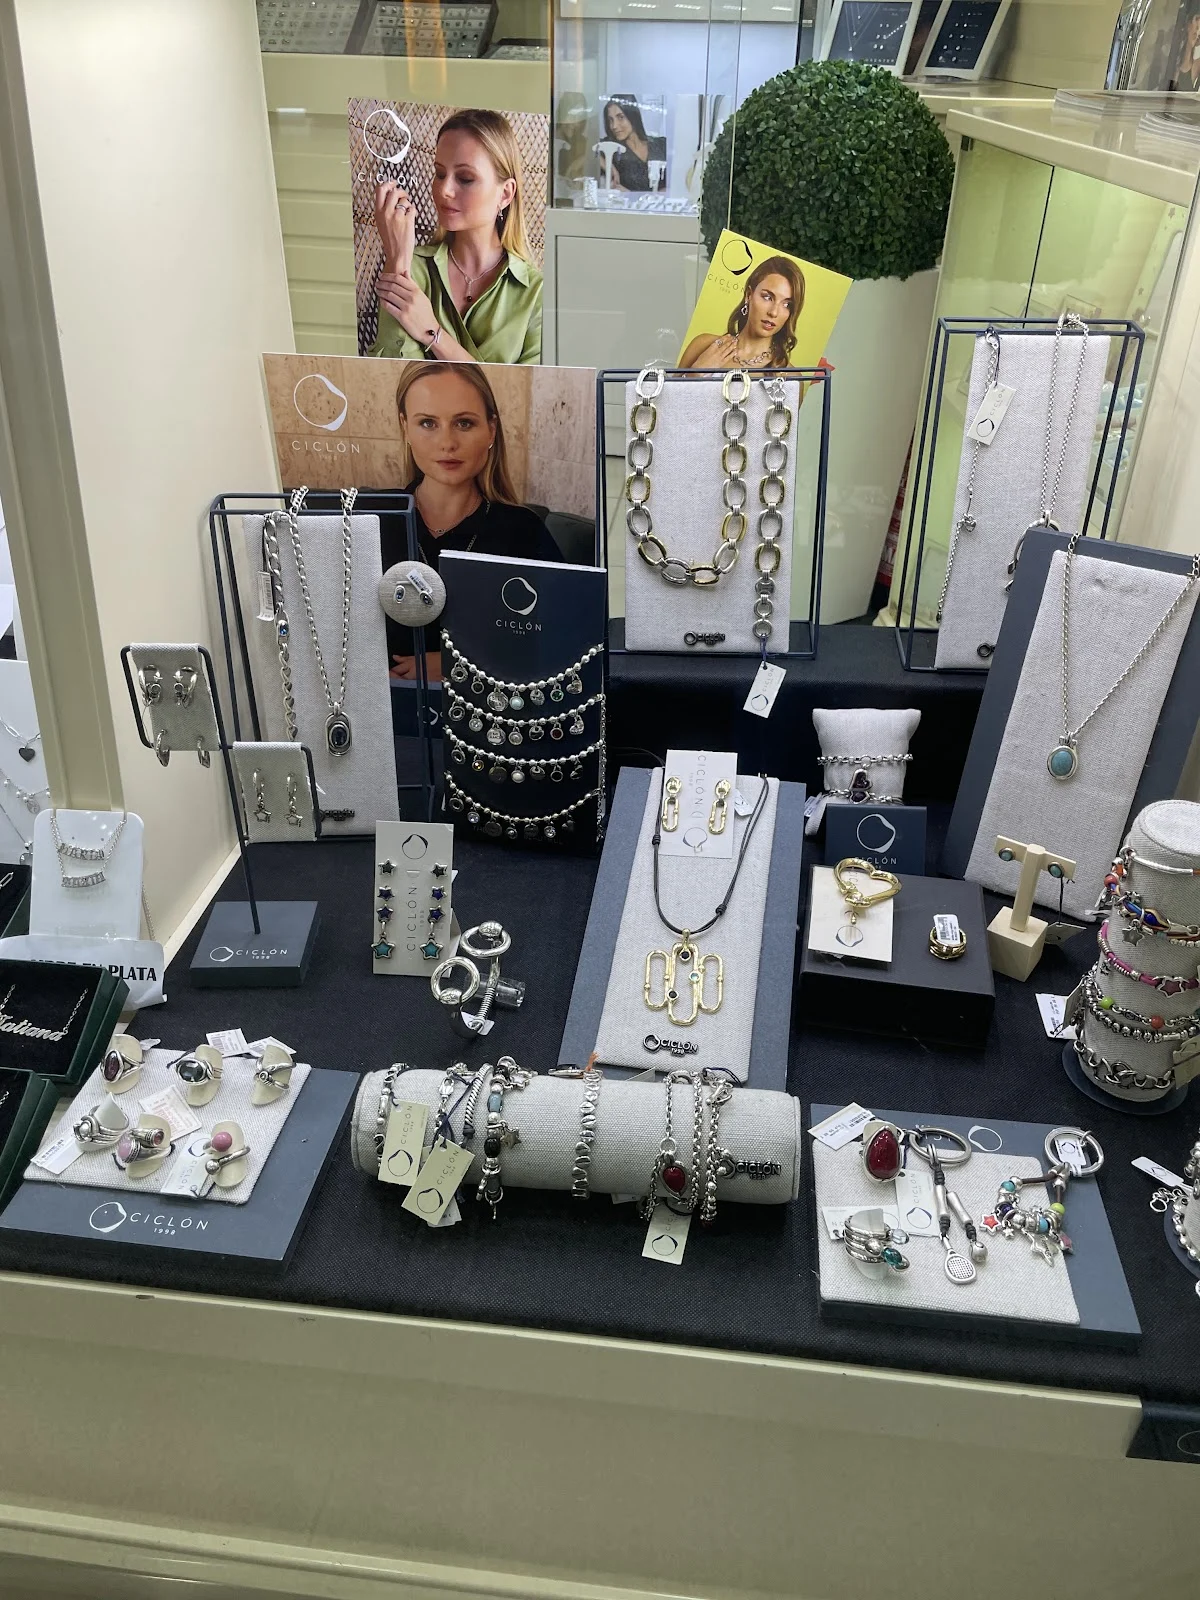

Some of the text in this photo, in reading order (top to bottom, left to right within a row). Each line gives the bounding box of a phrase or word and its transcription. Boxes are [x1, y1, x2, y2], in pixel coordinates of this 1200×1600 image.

[291, 440, 361, 454] CICLÓN
[495, 619, 542, 632] CICLÓN
[695, 755, 707, 805] CICLÓN
[855, 857, 897, 865] CLÓN
[405, 886, 418, 952] CICLÓN
[235, 948, 288, 956] CICLÓN
[108, 965, 157, 981] PLATA
[130, 1212, 209, 1230] CICLÓN
[153, 1227, 176, 1236] 1998
